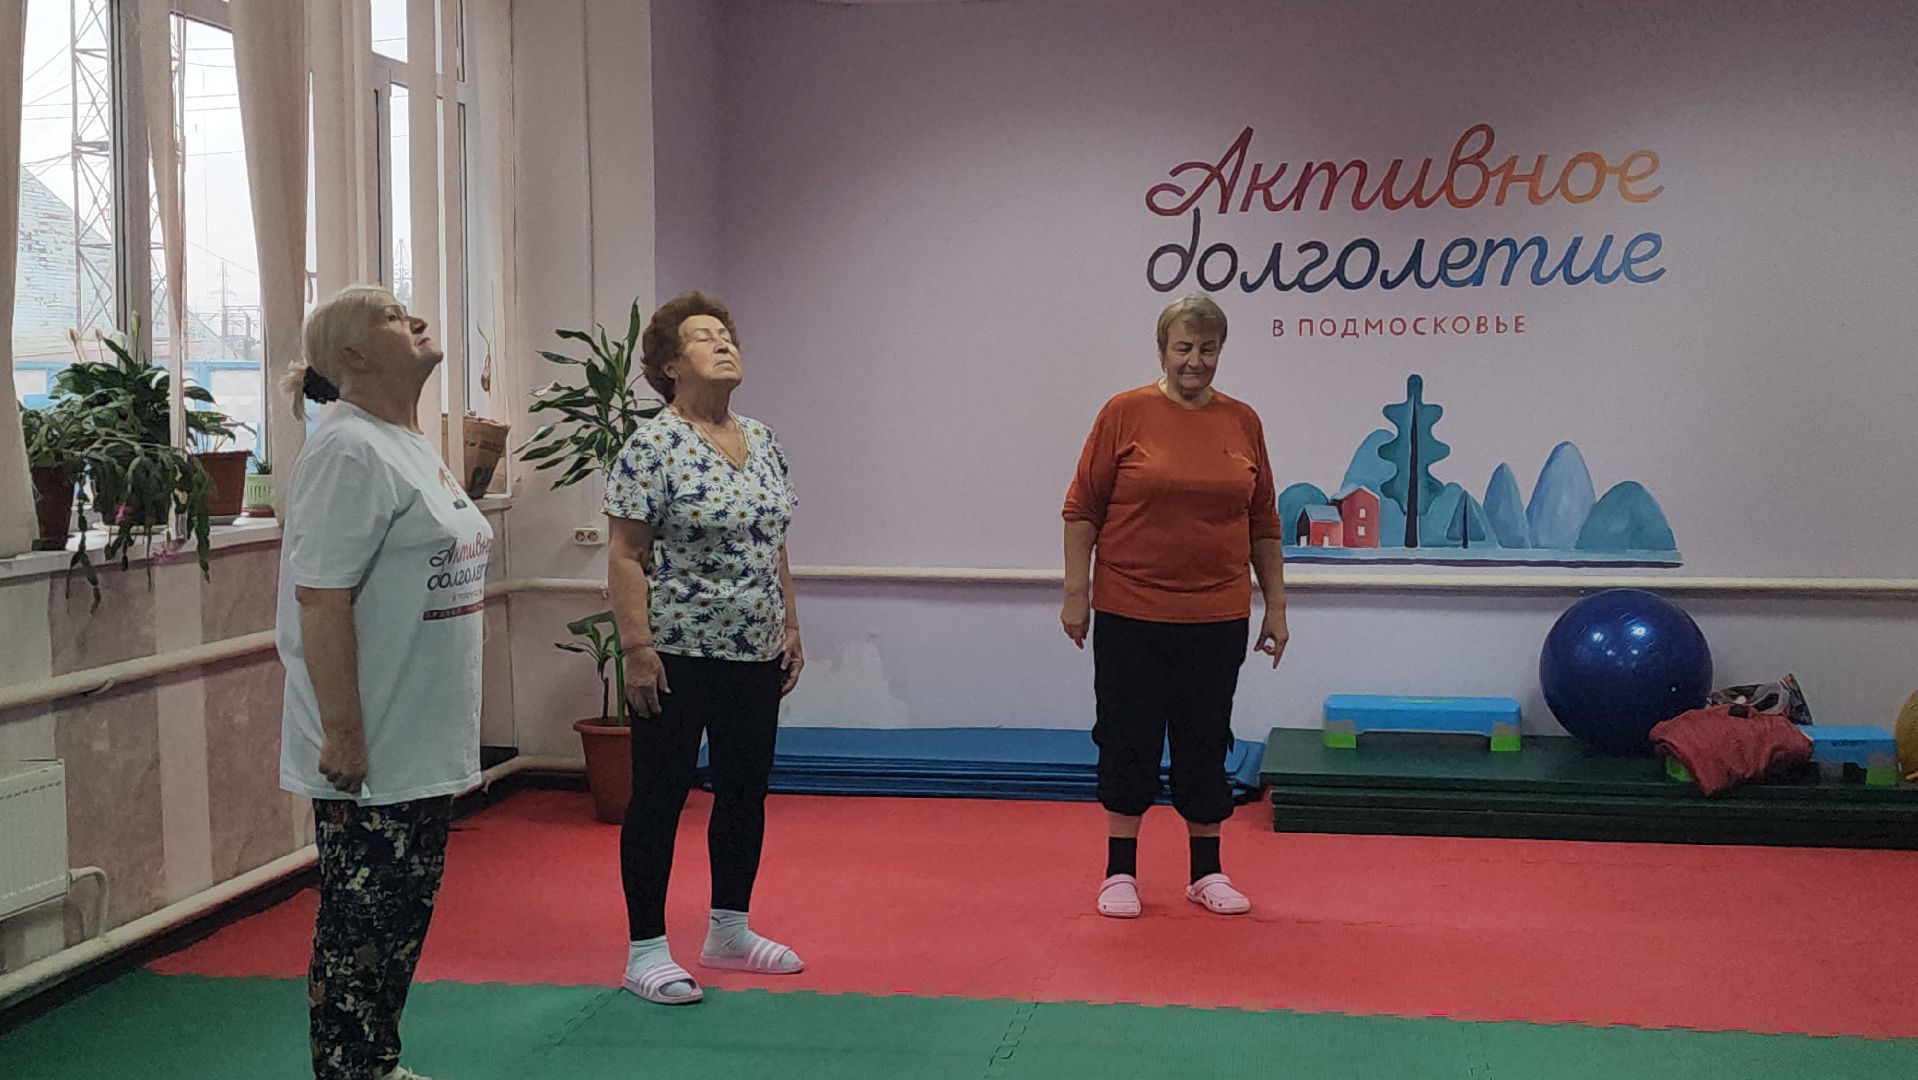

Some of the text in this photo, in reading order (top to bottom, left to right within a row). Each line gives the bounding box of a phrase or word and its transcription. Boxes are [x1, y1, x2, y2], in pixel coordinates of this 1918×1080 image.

[1145, 123, 1664, 217] Активное
[1146, 206, 1667, 293] долголетие
[1298, 314, 1527, 339] ПОДМОСКОВЬЕ
